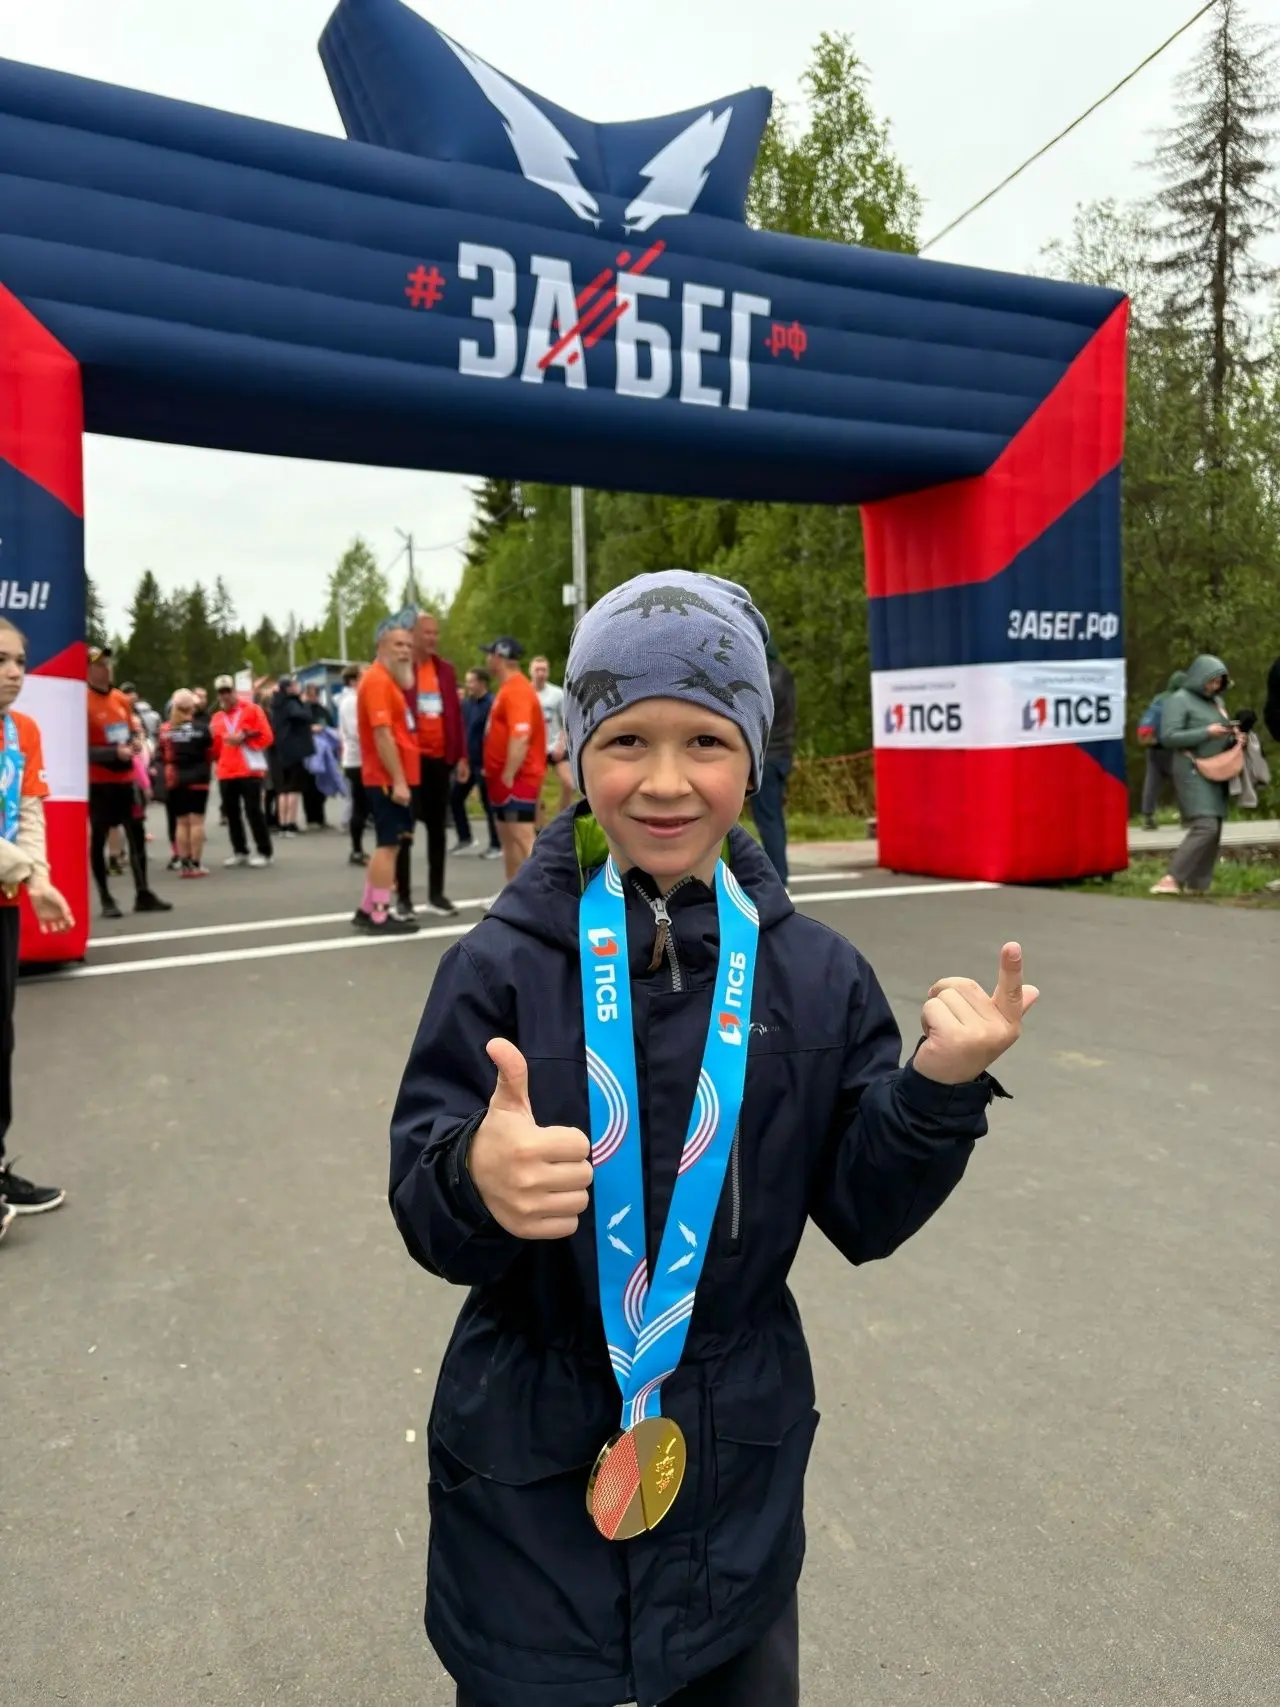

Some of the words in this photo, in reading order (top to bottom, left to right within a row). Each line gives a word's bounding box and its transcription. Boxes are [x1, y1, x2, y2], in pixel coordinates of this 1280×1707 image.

[1007, 609, 1119, 641] ЗАБЕГ.РФ
[909, 702, 962, 733] ПСБ
[1053, 695, 1112, 729] ПСБ
[594, 964, 618, 1022] ПСБ
[725, 952, 747, 1008] ПСБ
